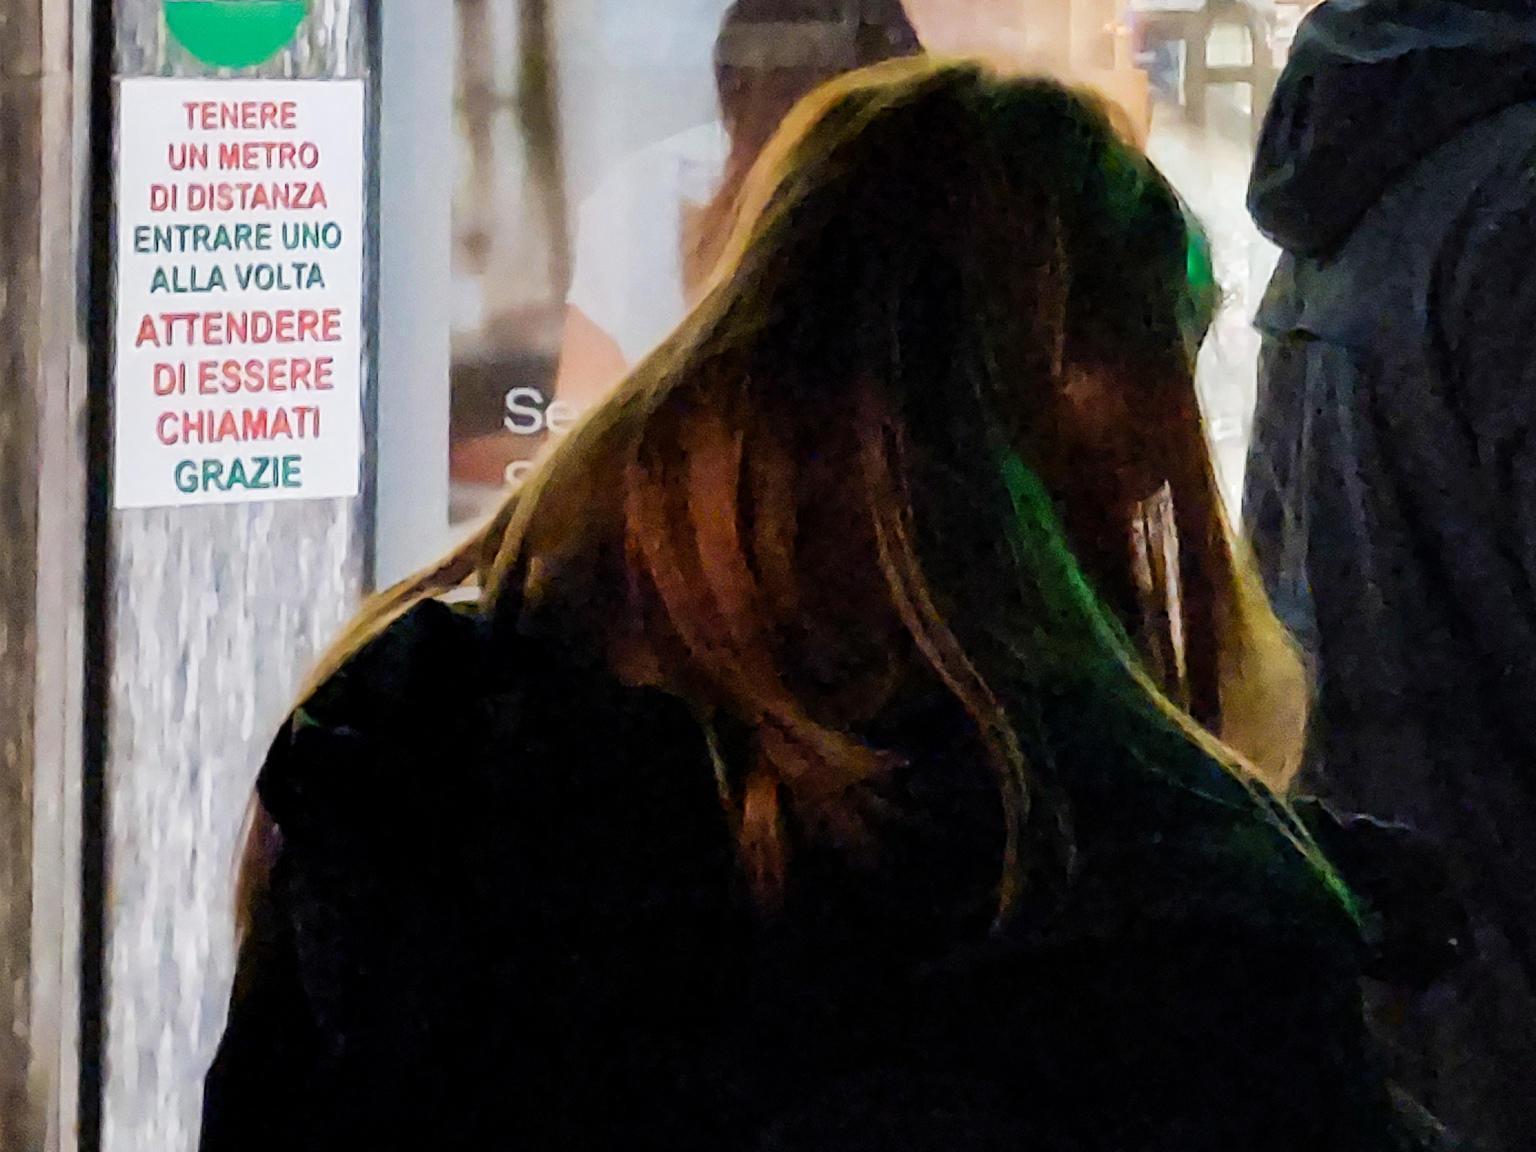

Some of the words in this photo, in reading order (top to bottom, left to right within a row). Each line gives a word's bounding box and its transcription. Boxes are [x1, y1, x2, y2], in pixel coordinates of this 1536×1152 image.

[184, 102, 297, 130] TENERE
[168, 144, 208, 170] UN
[219, 143, 319, 169] METRO
[150, 185, 178, 211] DI
[188, 183, 327, 210] DISTANZA
[133, 224, 271, 252] ENTRARE
[281, 222, 342, 249] UNO
[150, 266, 226, 293] ALLA
[235, 263, 325, 290] VOLTA
[135, 310, 341, 346] ATTENDERE
[153, 364, 186, 396] DI
[199, 358, 334, 394] ESSERE
[157, 407, 320, 445] CHIAMATI
[174, 455, 302, 493] GRAZIE
